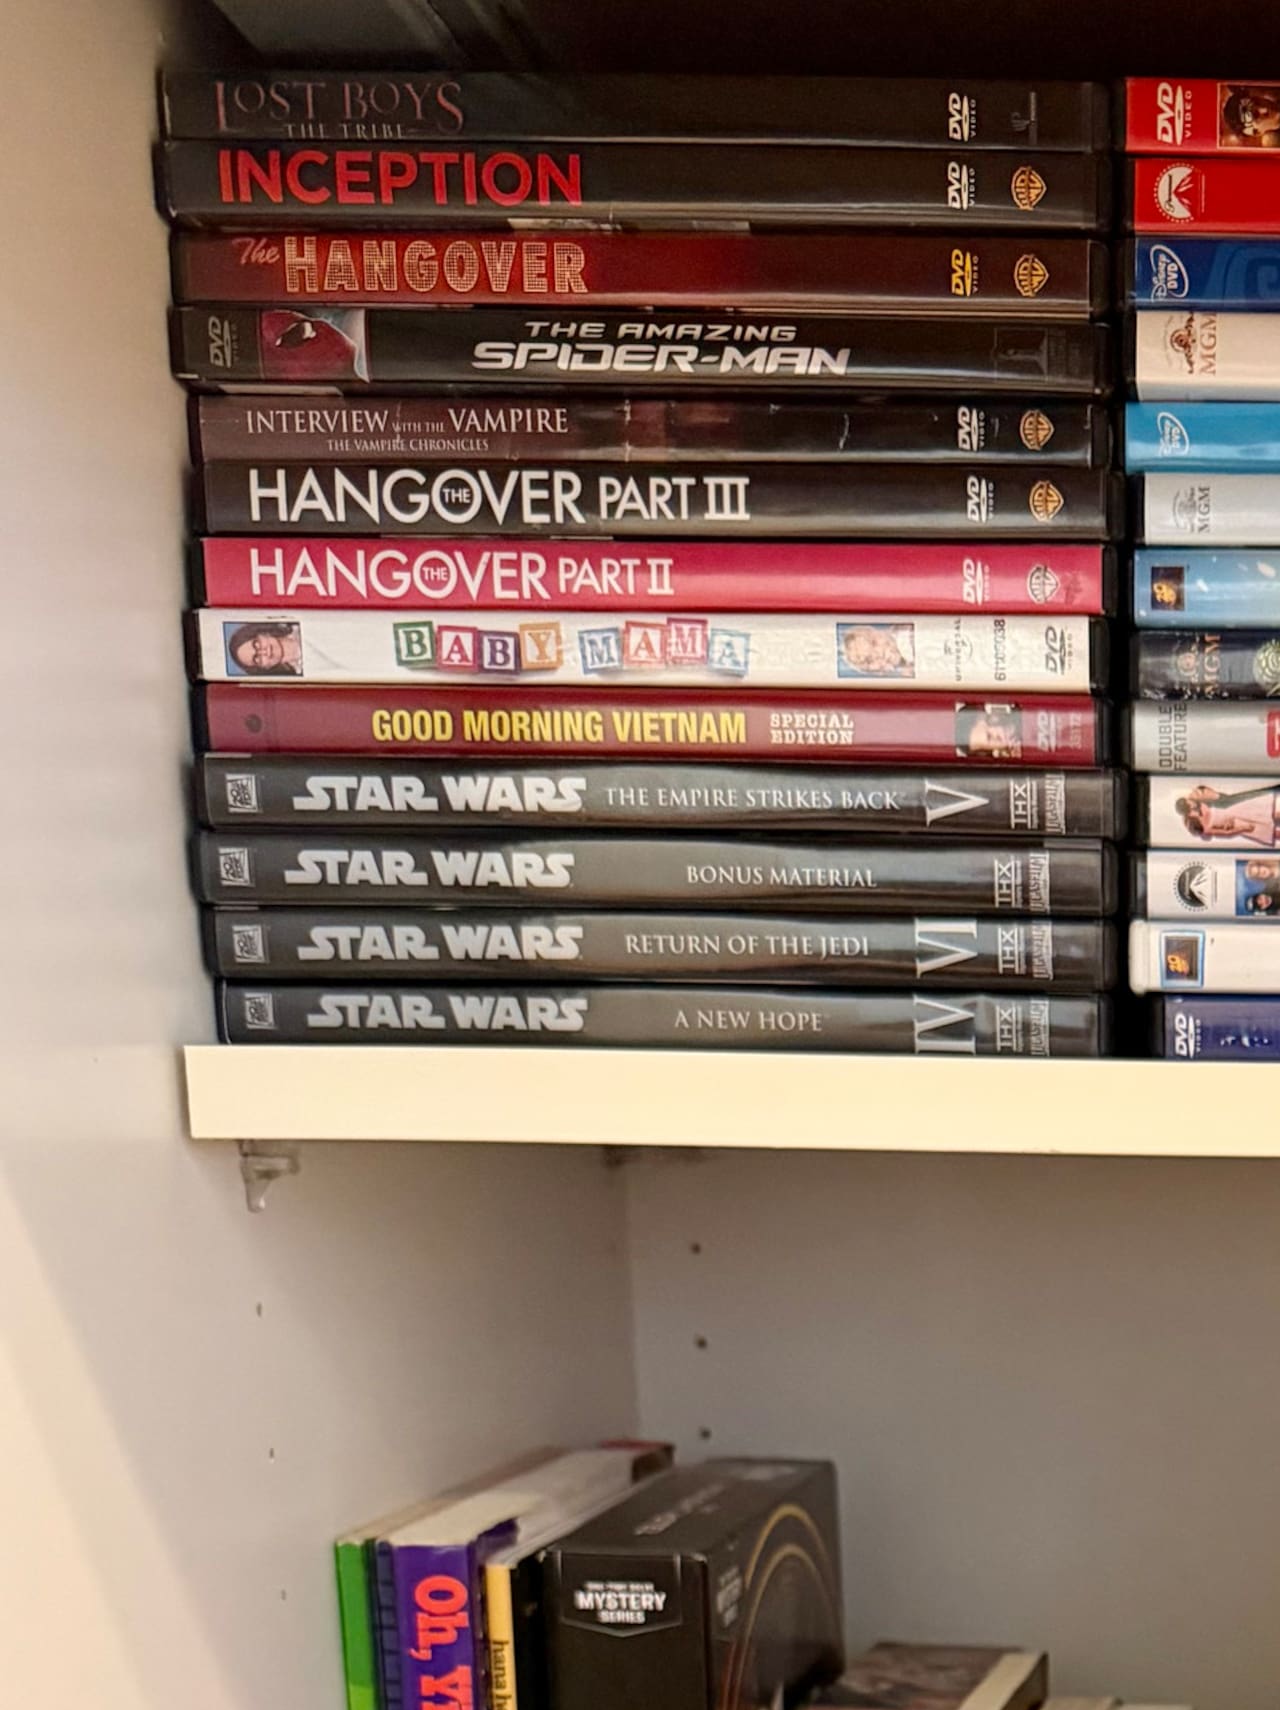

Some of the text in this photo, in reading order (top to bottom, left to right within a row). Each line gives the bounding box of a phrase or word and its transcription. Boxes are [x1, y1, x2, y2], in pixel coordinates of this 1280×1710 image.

[214, 81, 464, 133] LOST BOYS
[218, 149, 583, 207] INCEPTION
[231, 236, 589, 293] The HANGOVER
[525, 322, 797, 342] THE AMAZING
[471, 342, 851, 375] SPIDER-MAN
[247, 408, 568, 434] INTERVIEW VAMPIRE
[409, 439, 489, 452] CHRONICLES
[249, 468, 750, 525] HANGOVER PART III
[442, 487, 472, 504] THE
[250, 548, 673, 600] HANGOVER PART II
[422, 566, 449, 581] THE
[396, 620, 749, 676] BABY MAMA
[372, 710, 746, 744] GOOD MORNING VIETNAM
[770, 714, 854, 729] SPECIAL
[771, 730, 854, 745] EDITION
[1160, 706, 1172, 768] DOUBLE
[1174, 704, 1188, 771] FEATURE
[293, 776, 439, 811] STAR
[441, 776, 587, 812] WARS
[605, 788, 900, 810] THE EMPIRE STRIKES BACK
[284, 850, 428, 886] STAR
[432, 851, 575, 887] WARS
[687, 866, 877, 887] BONUS MATERIAL
[298, 925, 439, 960] STAR
[441, 926, 583, 961] WARS
[626, 935, 869, 959] RETURN OF THE JEDI
[308, 995, 445, 1029] STAR
[449, 997, 588, 1031] WARS
[698, 1011, 823, 1031] NEW HOPE
[409, 1575, 469, 1661] Oh,
[575, 1591, 667, 1611] MYSTERY
[598, 1610, 646, 1624] SERIES
[491, 1640, 509, 1691] hana
